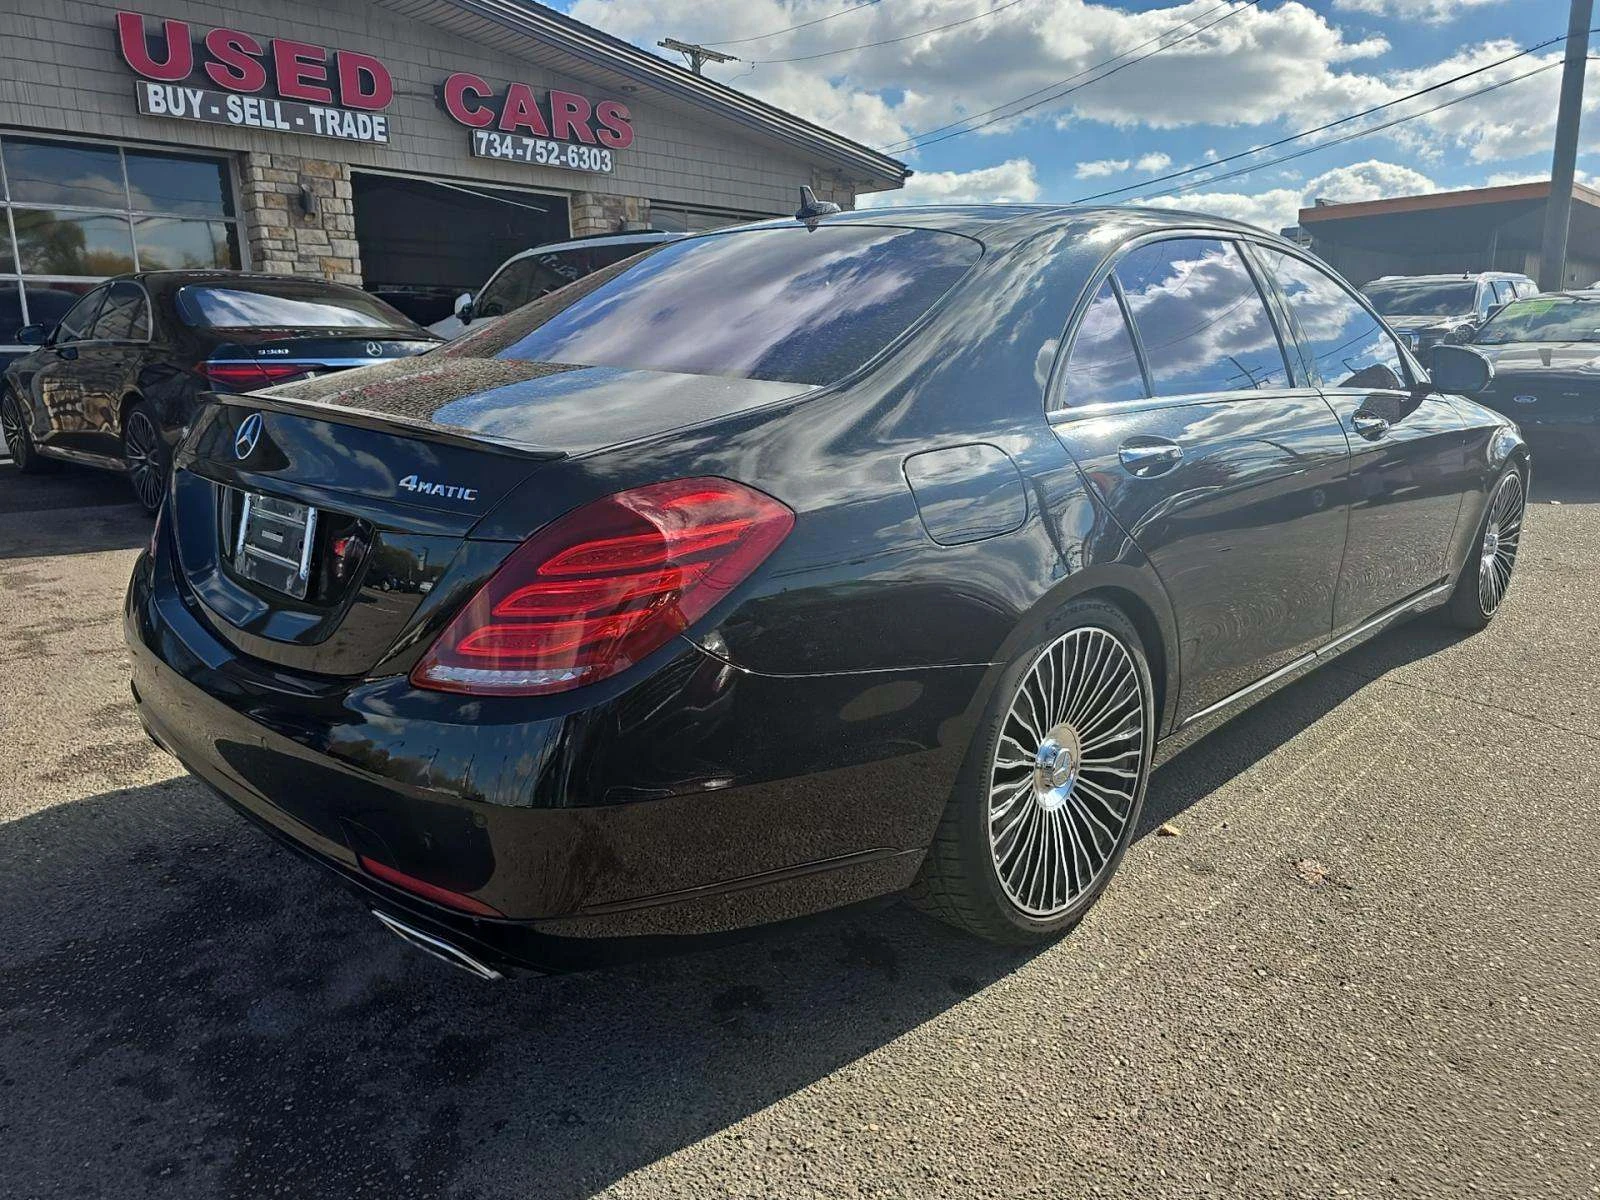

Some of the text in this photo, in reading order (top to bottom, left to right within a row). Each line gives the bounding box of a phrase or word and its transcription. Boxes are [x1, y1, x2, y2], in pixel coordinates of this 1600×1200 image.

[117, 11, 635, 149] USED CARS
[147, 83, 204, 118] BUY
[226, 94, 290, 130] SELL
[309, 107, 389, 142] TRADE
[476, 131, 613, 172] 734-752-6303
[398, 474, 479, 501] 4MATIC
